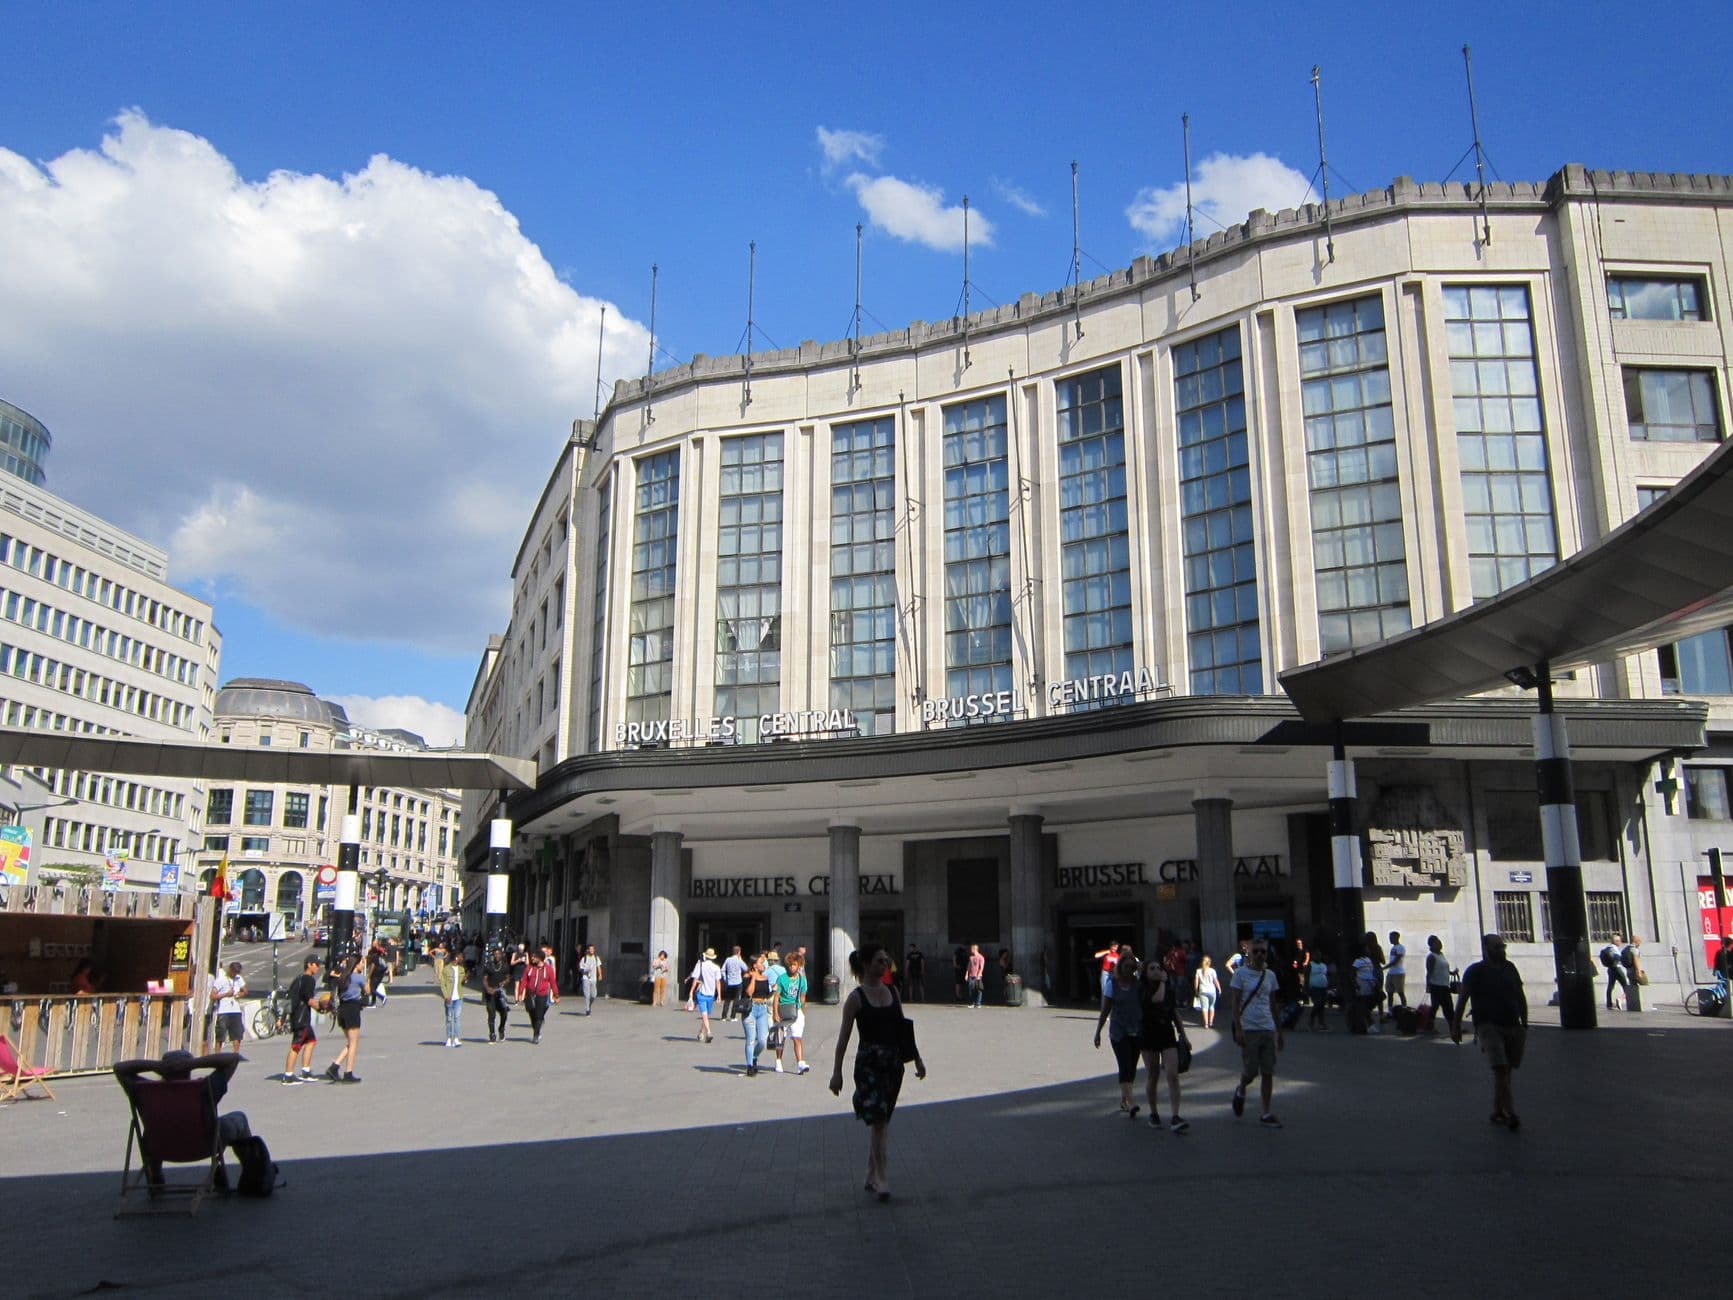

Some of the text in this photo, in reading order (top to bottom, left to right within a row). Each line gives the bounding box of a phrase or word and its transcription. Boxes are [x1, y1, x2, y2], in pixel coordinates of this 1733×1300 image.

[923, 666, 1168, 721] BRUSSEL CENTRAAL
[616, 708, 856, 742] BRUXELLES CENTRAL
[693, 875, 900, 897] BRUXELLES CERAL
[1059, 855, 1288, 887] BRUSSEL CENAAL
